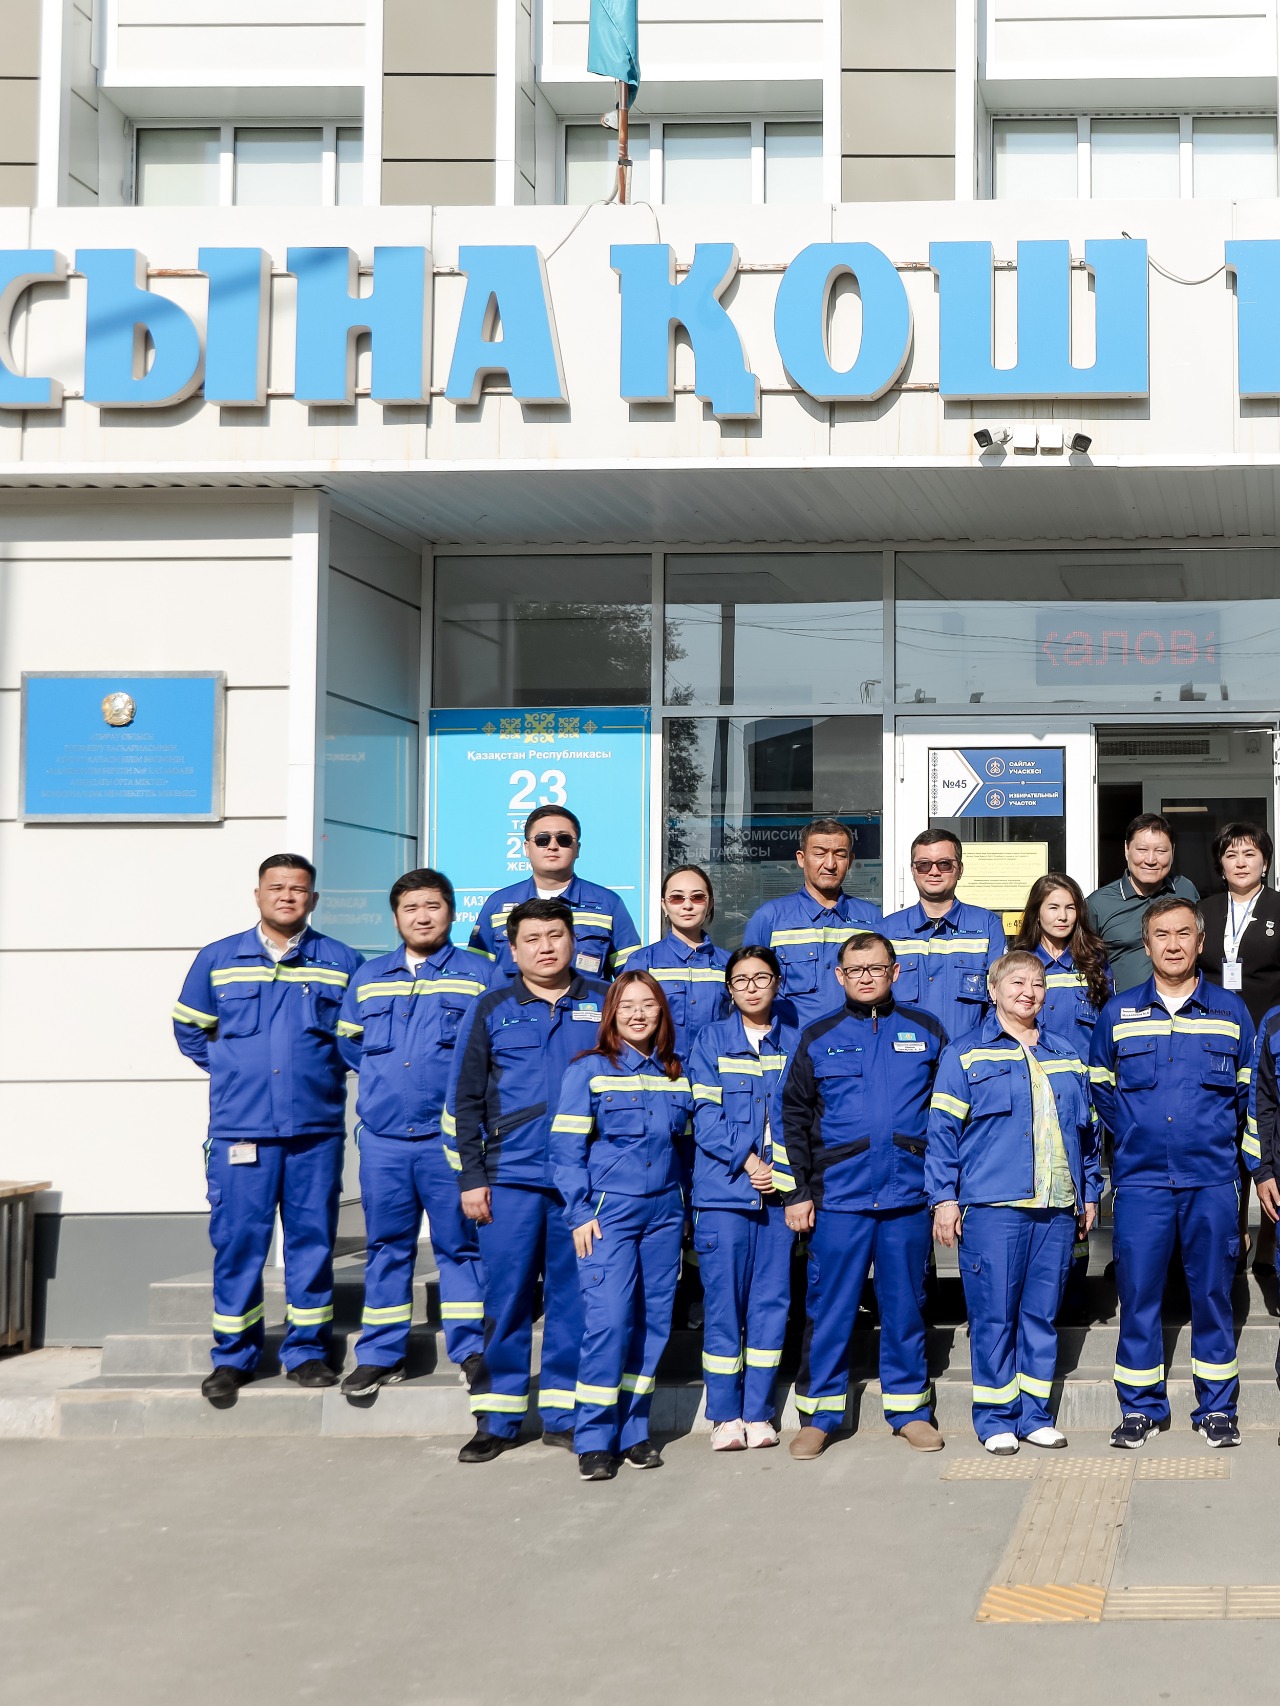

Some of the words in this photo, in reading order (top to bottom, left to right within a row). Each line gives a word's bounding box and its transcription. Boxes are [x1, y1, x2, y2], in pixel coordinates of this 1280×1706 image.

[610, 239, 1149, 420] ҚОШ
[467, 750, 526, 762] Қазақстан
[529, 749, 611, 761] Республикасы
[508, 769, 568, 810] 23
[942, 779, 967, 789] №45
[1008, 791, 1059, 799] ИЗБИРАТЕЛЬНЫЙ
